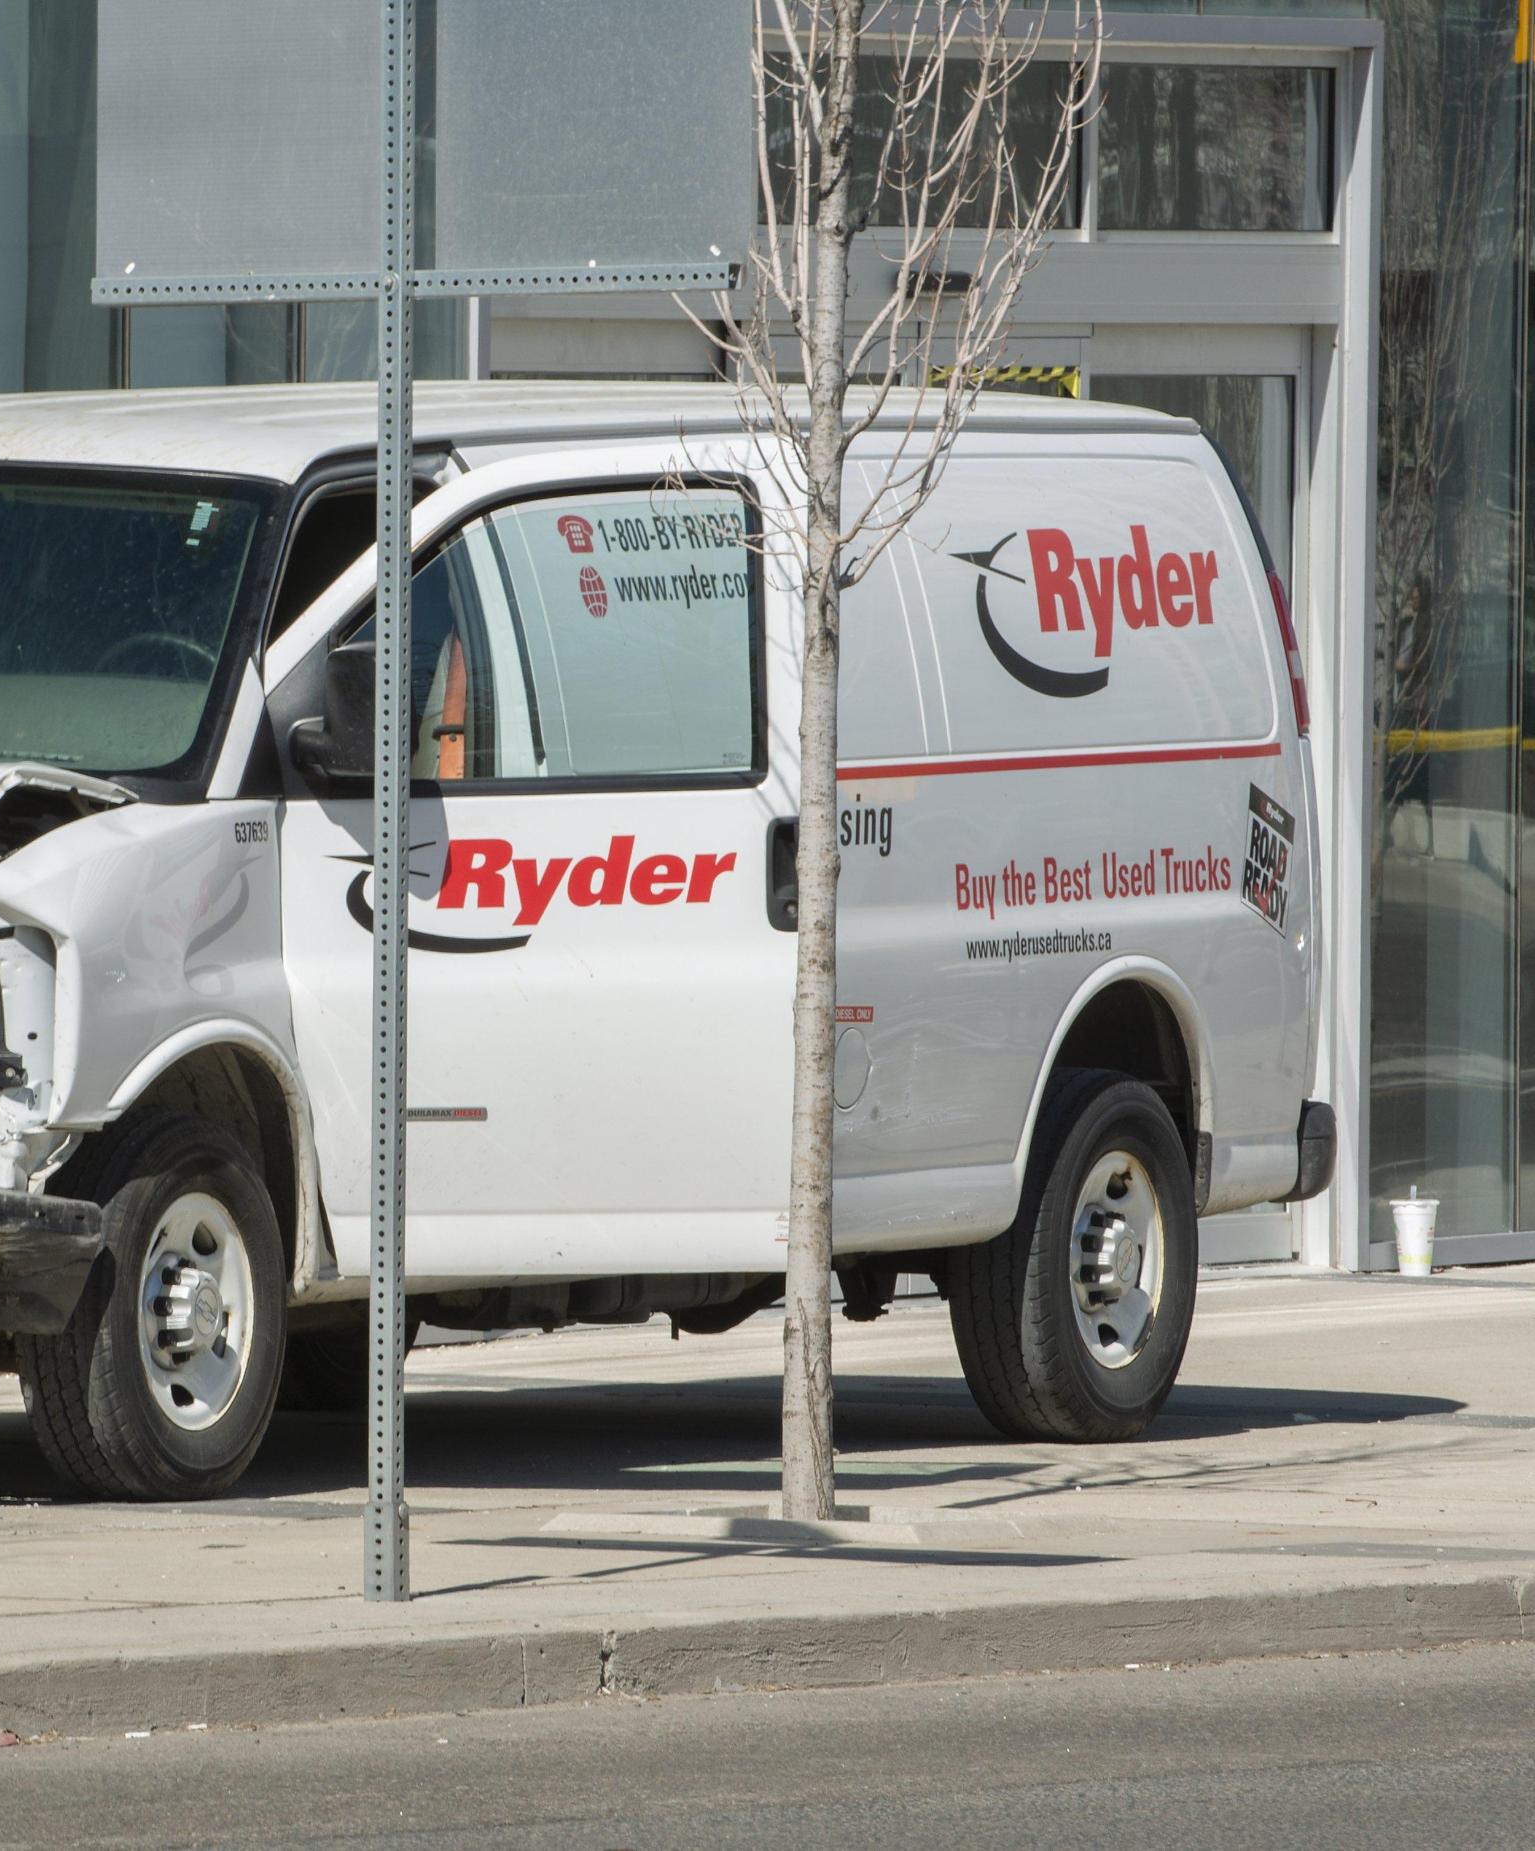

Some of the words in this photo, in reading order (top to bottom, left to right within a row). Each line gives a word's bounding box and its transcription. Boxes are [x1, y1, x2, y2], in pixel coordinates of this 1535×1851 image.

[1026, 524, 1219, 658] Ryder
[235, 821, 268, 843] 637639
[1249, 818, 1289, 883] ROAD
[437, 834, 737, 926] Ryder
[955, 863, 996, 920] Buy
[1002, 860, 1036, 907] the
[1043, 857, 1092, 904] Best
[1102, 849, 1156, 899] Used
[1160, 845, 1232, 894] Trucks
[1242, 858, 1288, 929] READY
[966, 927, 1112, 963] www.ryderusedtrucks.ca
[856, 1008, 872, 1020] ONLY
[407, 1109, 452, 1118] DURAMAX
